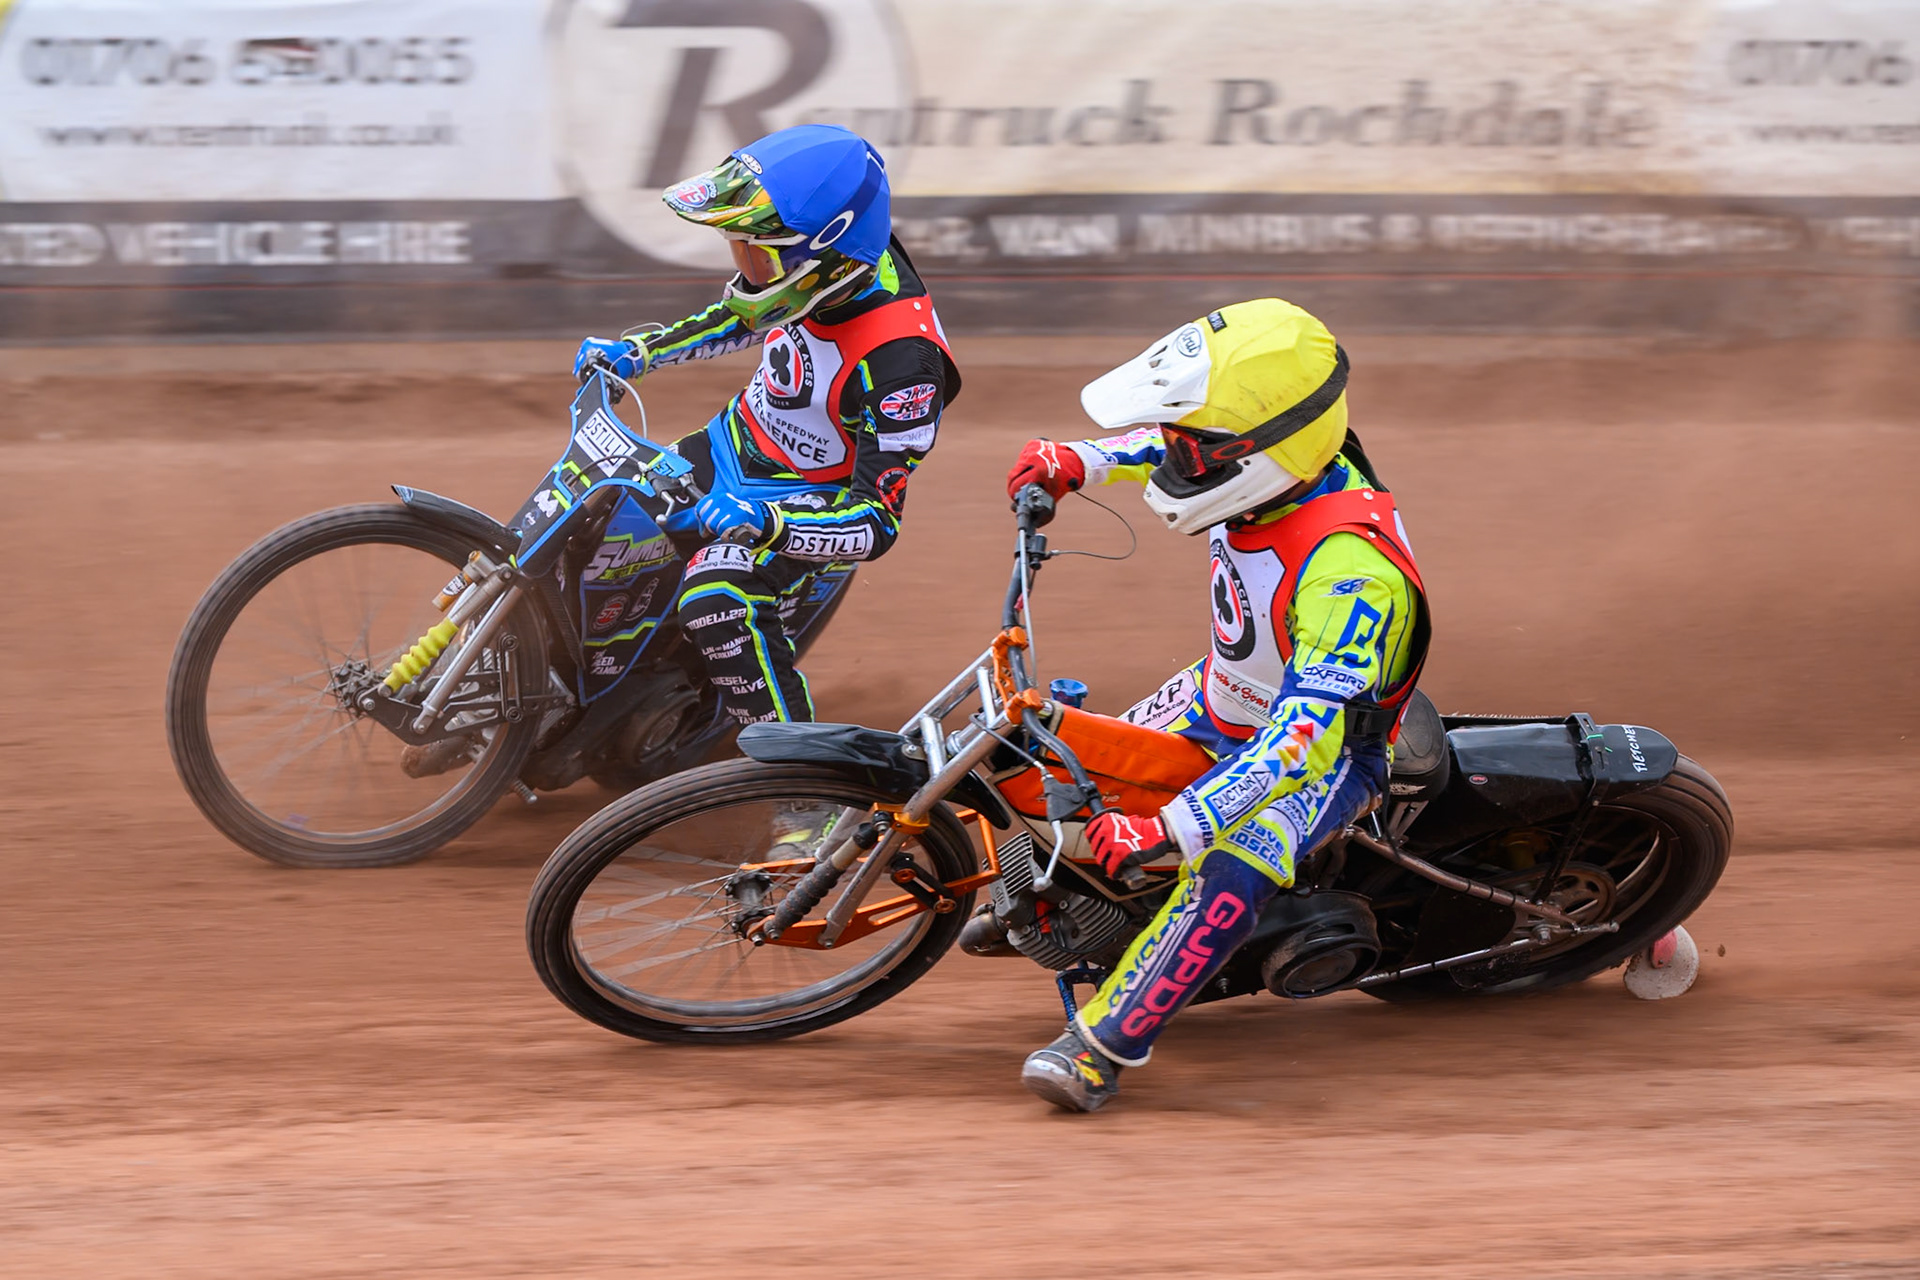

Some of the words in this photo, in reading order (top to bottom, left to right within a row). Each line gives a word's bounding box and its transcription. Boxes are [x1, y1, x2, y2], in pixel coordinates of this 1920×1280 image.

[801, 353, 813, 388] ACES
[774, 417, 830, 446] SPEEDWAY
[703, 545, 751, 562] FTS
[789, 535, 863, 554] DSTILL
[695, 561, 718, 571] Training
[731, 677, 767, 695] DAVE
[1302, 666, 1366, 691] OXFORD
[1621, 725, 1648, 773] FLETCHE
[1212, 775, 1256, 810] DUCTAIR
